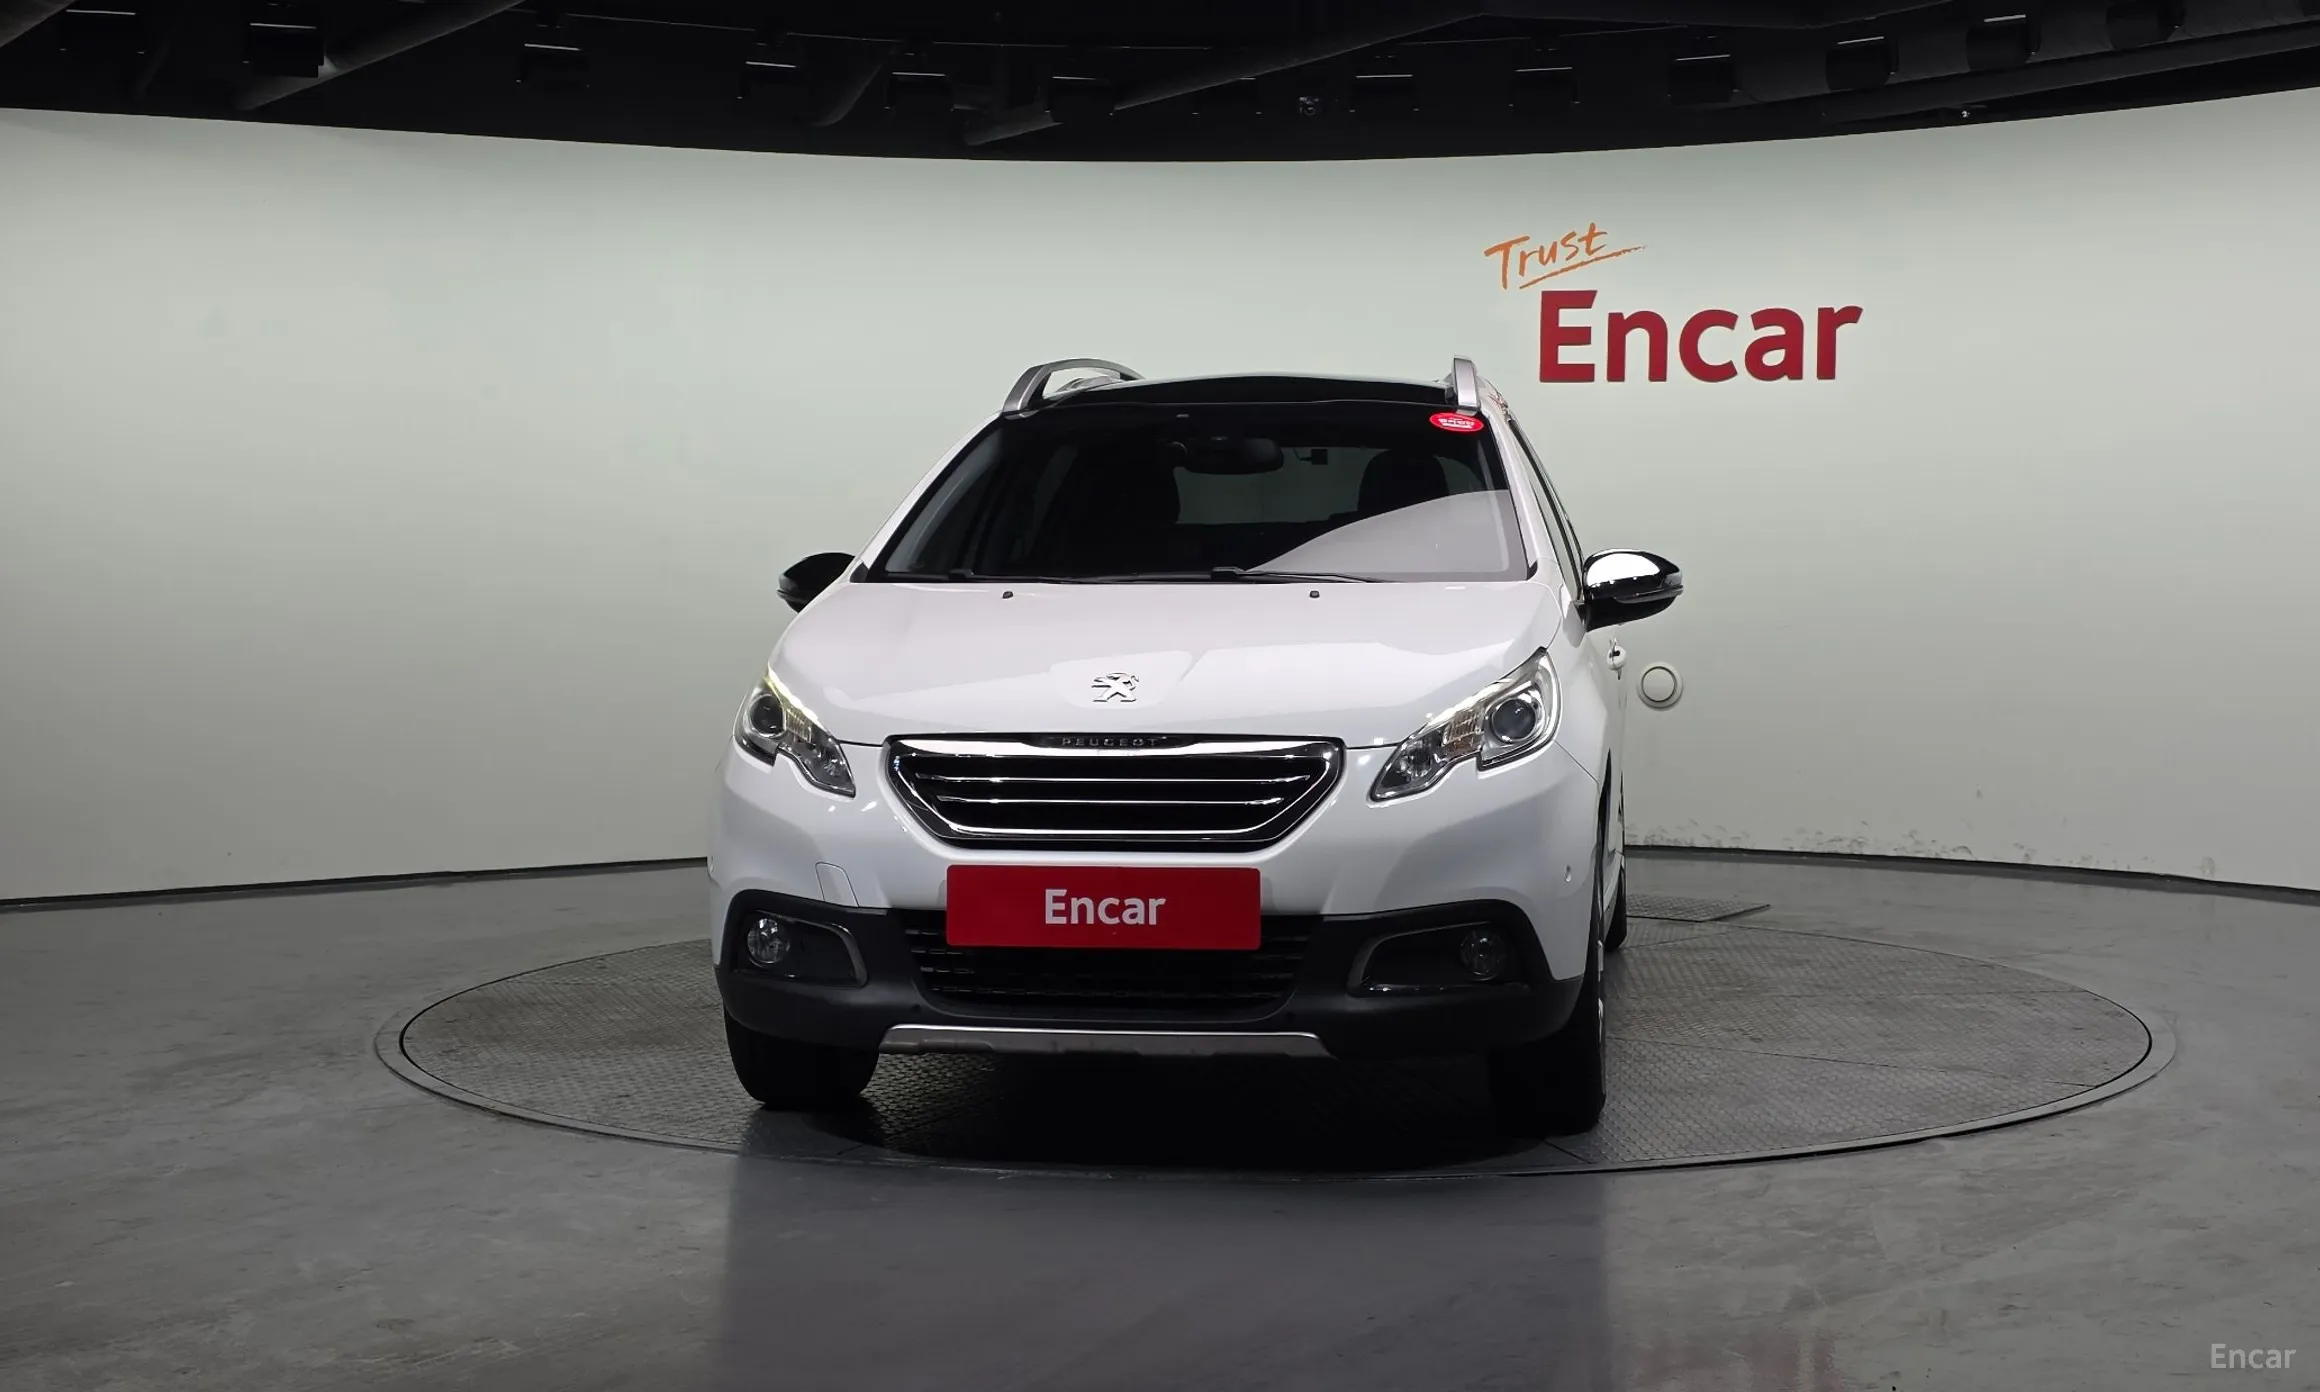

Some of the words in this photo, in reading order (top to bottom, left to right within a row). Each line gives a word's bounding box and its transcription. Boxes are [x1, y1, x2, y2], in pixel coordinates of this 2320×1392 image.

[1484, 222, 1608, 290] Trust
[1539, 290, 1864, 383] Encar
[1061, 737, 1157, 747] PEUGEOT
[1044, 888, 1166, 925] Encar
